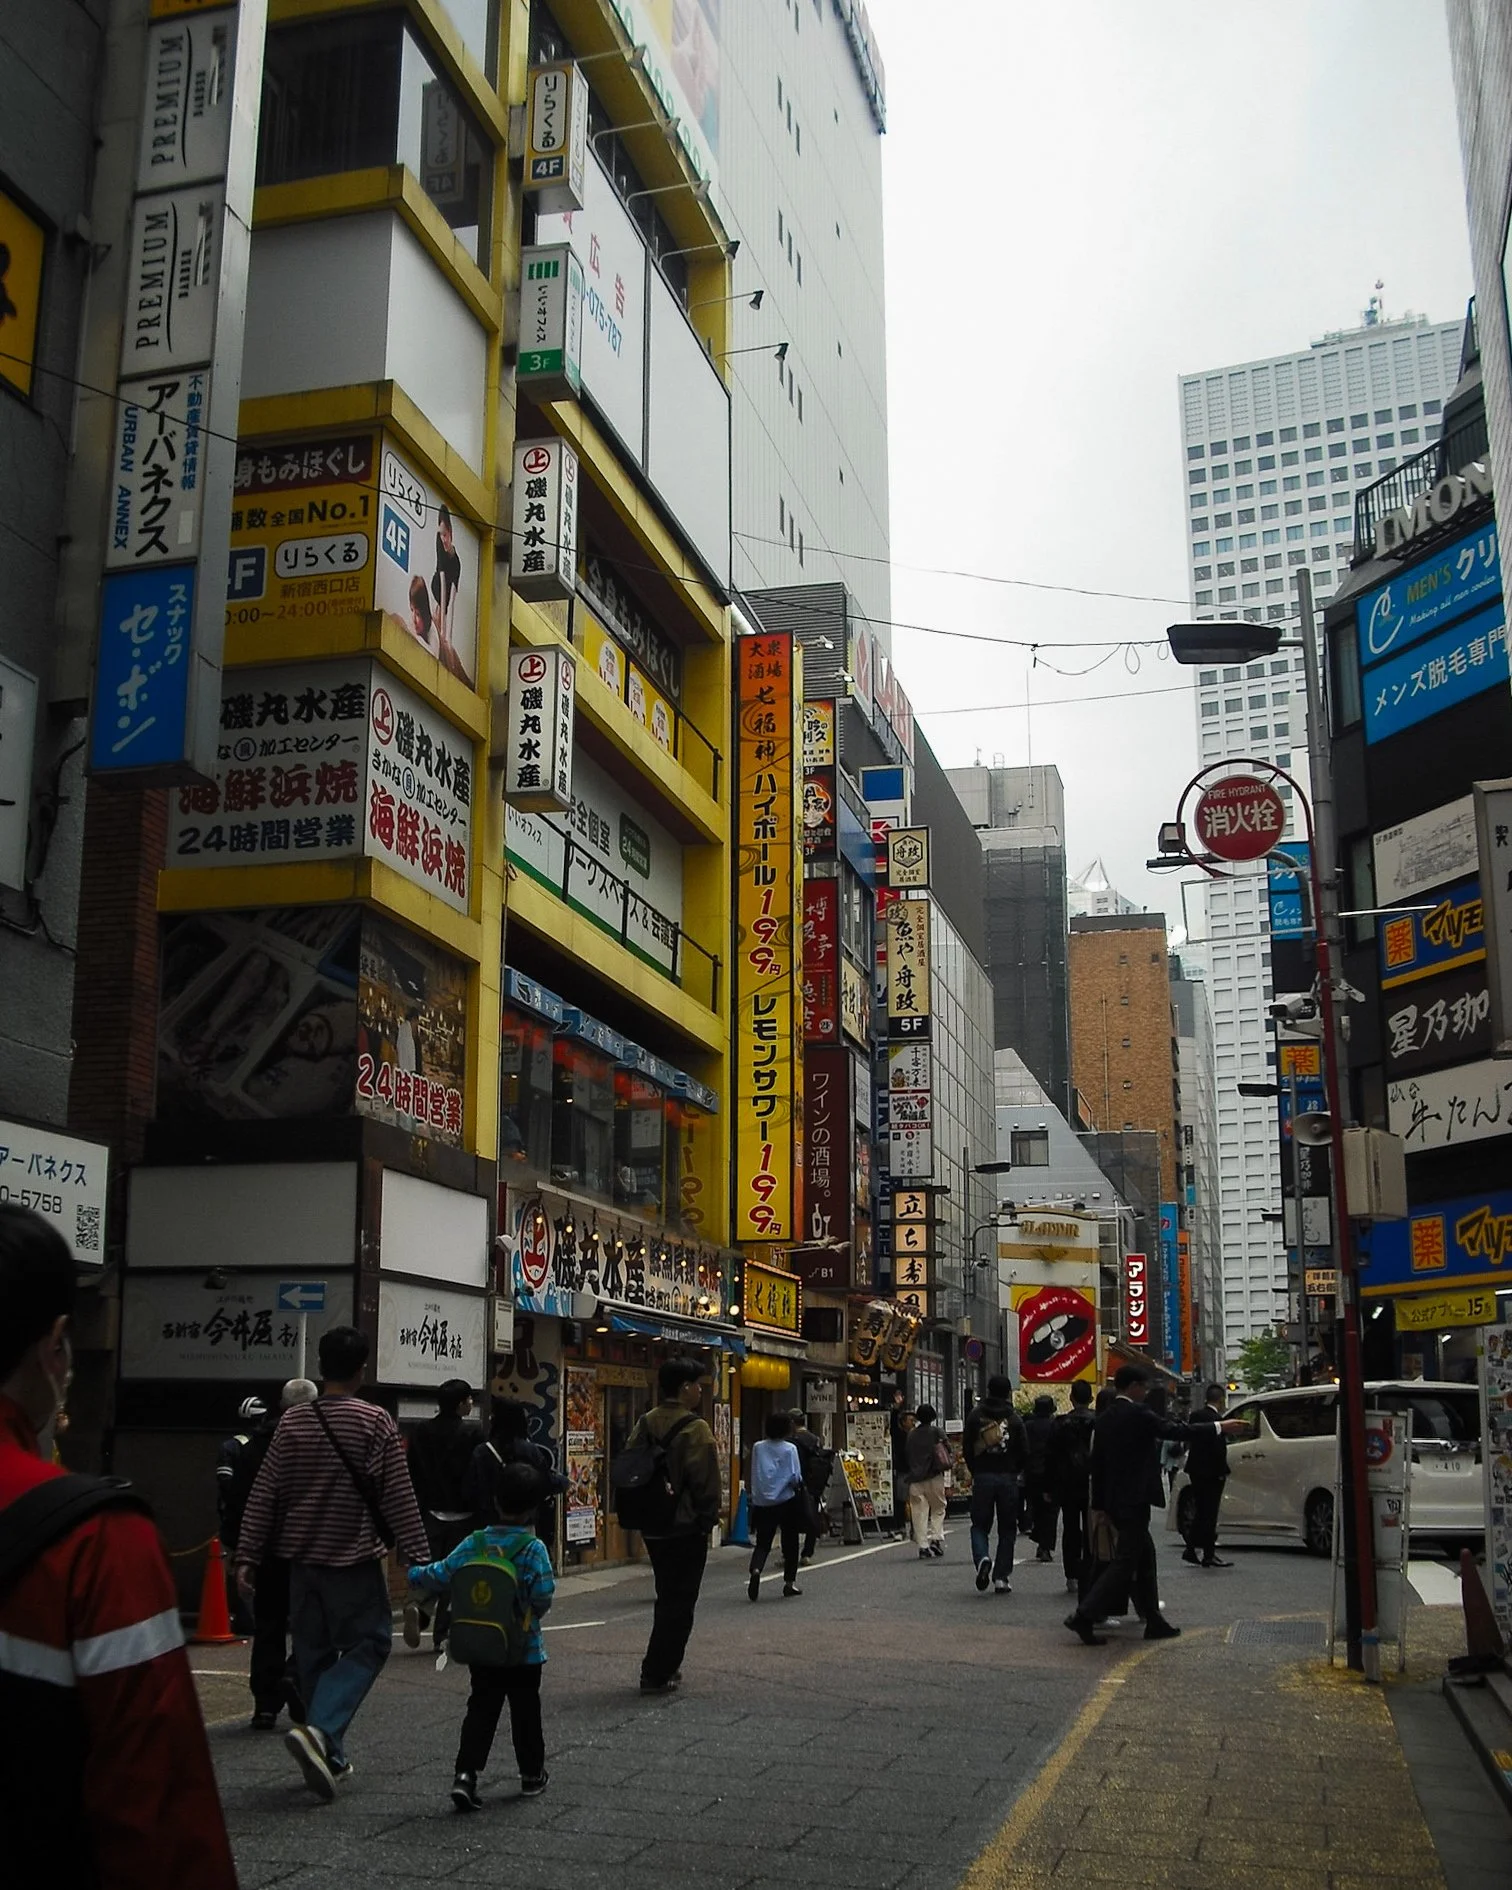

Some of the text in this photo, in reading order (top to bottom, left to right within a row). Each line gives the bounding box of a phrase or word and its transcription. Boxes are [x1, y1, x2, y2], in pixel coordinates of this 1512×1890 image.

[151, 35, 183, 167] PREMIUM
[541, 74, 558, 149] りらくる
[536, 159, 561, 175] 4F
[136, 211, 169, 350] PREMIUM
[178, 249, 192, 298] BARBER
[536, 284, 548, 344] いいオフィス
[530, 354, 550, 371] 3F
[113, 406, 138, 550] URBAN ANNEX
[135, 382, 180, 557] アーバネクス
[387, 463, 422, 517] りらくる
[385, 519, 406, 558] 4F
[521, 477, 548, 573] 磯丸水産
[284, 542, 359, 570] りらくる
[1406, 564, 1452, 605] MEN'S
[164, 584, 188, 665] スナック
[220, 683, 366, 730] 磯丸水産
[754, 686, 776, 762] 七福神
[395, 710, 471, 807] 磯丸水産
[517, 687, 543, 789] 磯丸水産
[804, 767, 815, 775] 3F
[1208, 784, 1267, 800] FIRE HYDRANT
[177, 814, 356, 855] 24時間営業
[370, 779, 466, 898] 海鮮浜焼
[1203, 798, 1278, 838] 消火栓
[1387, 919, 1412, 964] 薬
[901, 1018, 923, 1031] 5F
[1388, 989, 1490, 1059] 星乃珈
[357, 1053, 463, 1136] 24時間営業
[810, 1072, 831, 1198] ワインの酒場。
[0, 1147, 87, 1186] アーバネクス
[552, 1217, 646, 1307] 磯丸水産
[1414, 1219, 1444, 1267] 薬
[821, 1268, 834, 1279] B1
[1128, 1261, 1145, 1338] アラジン
